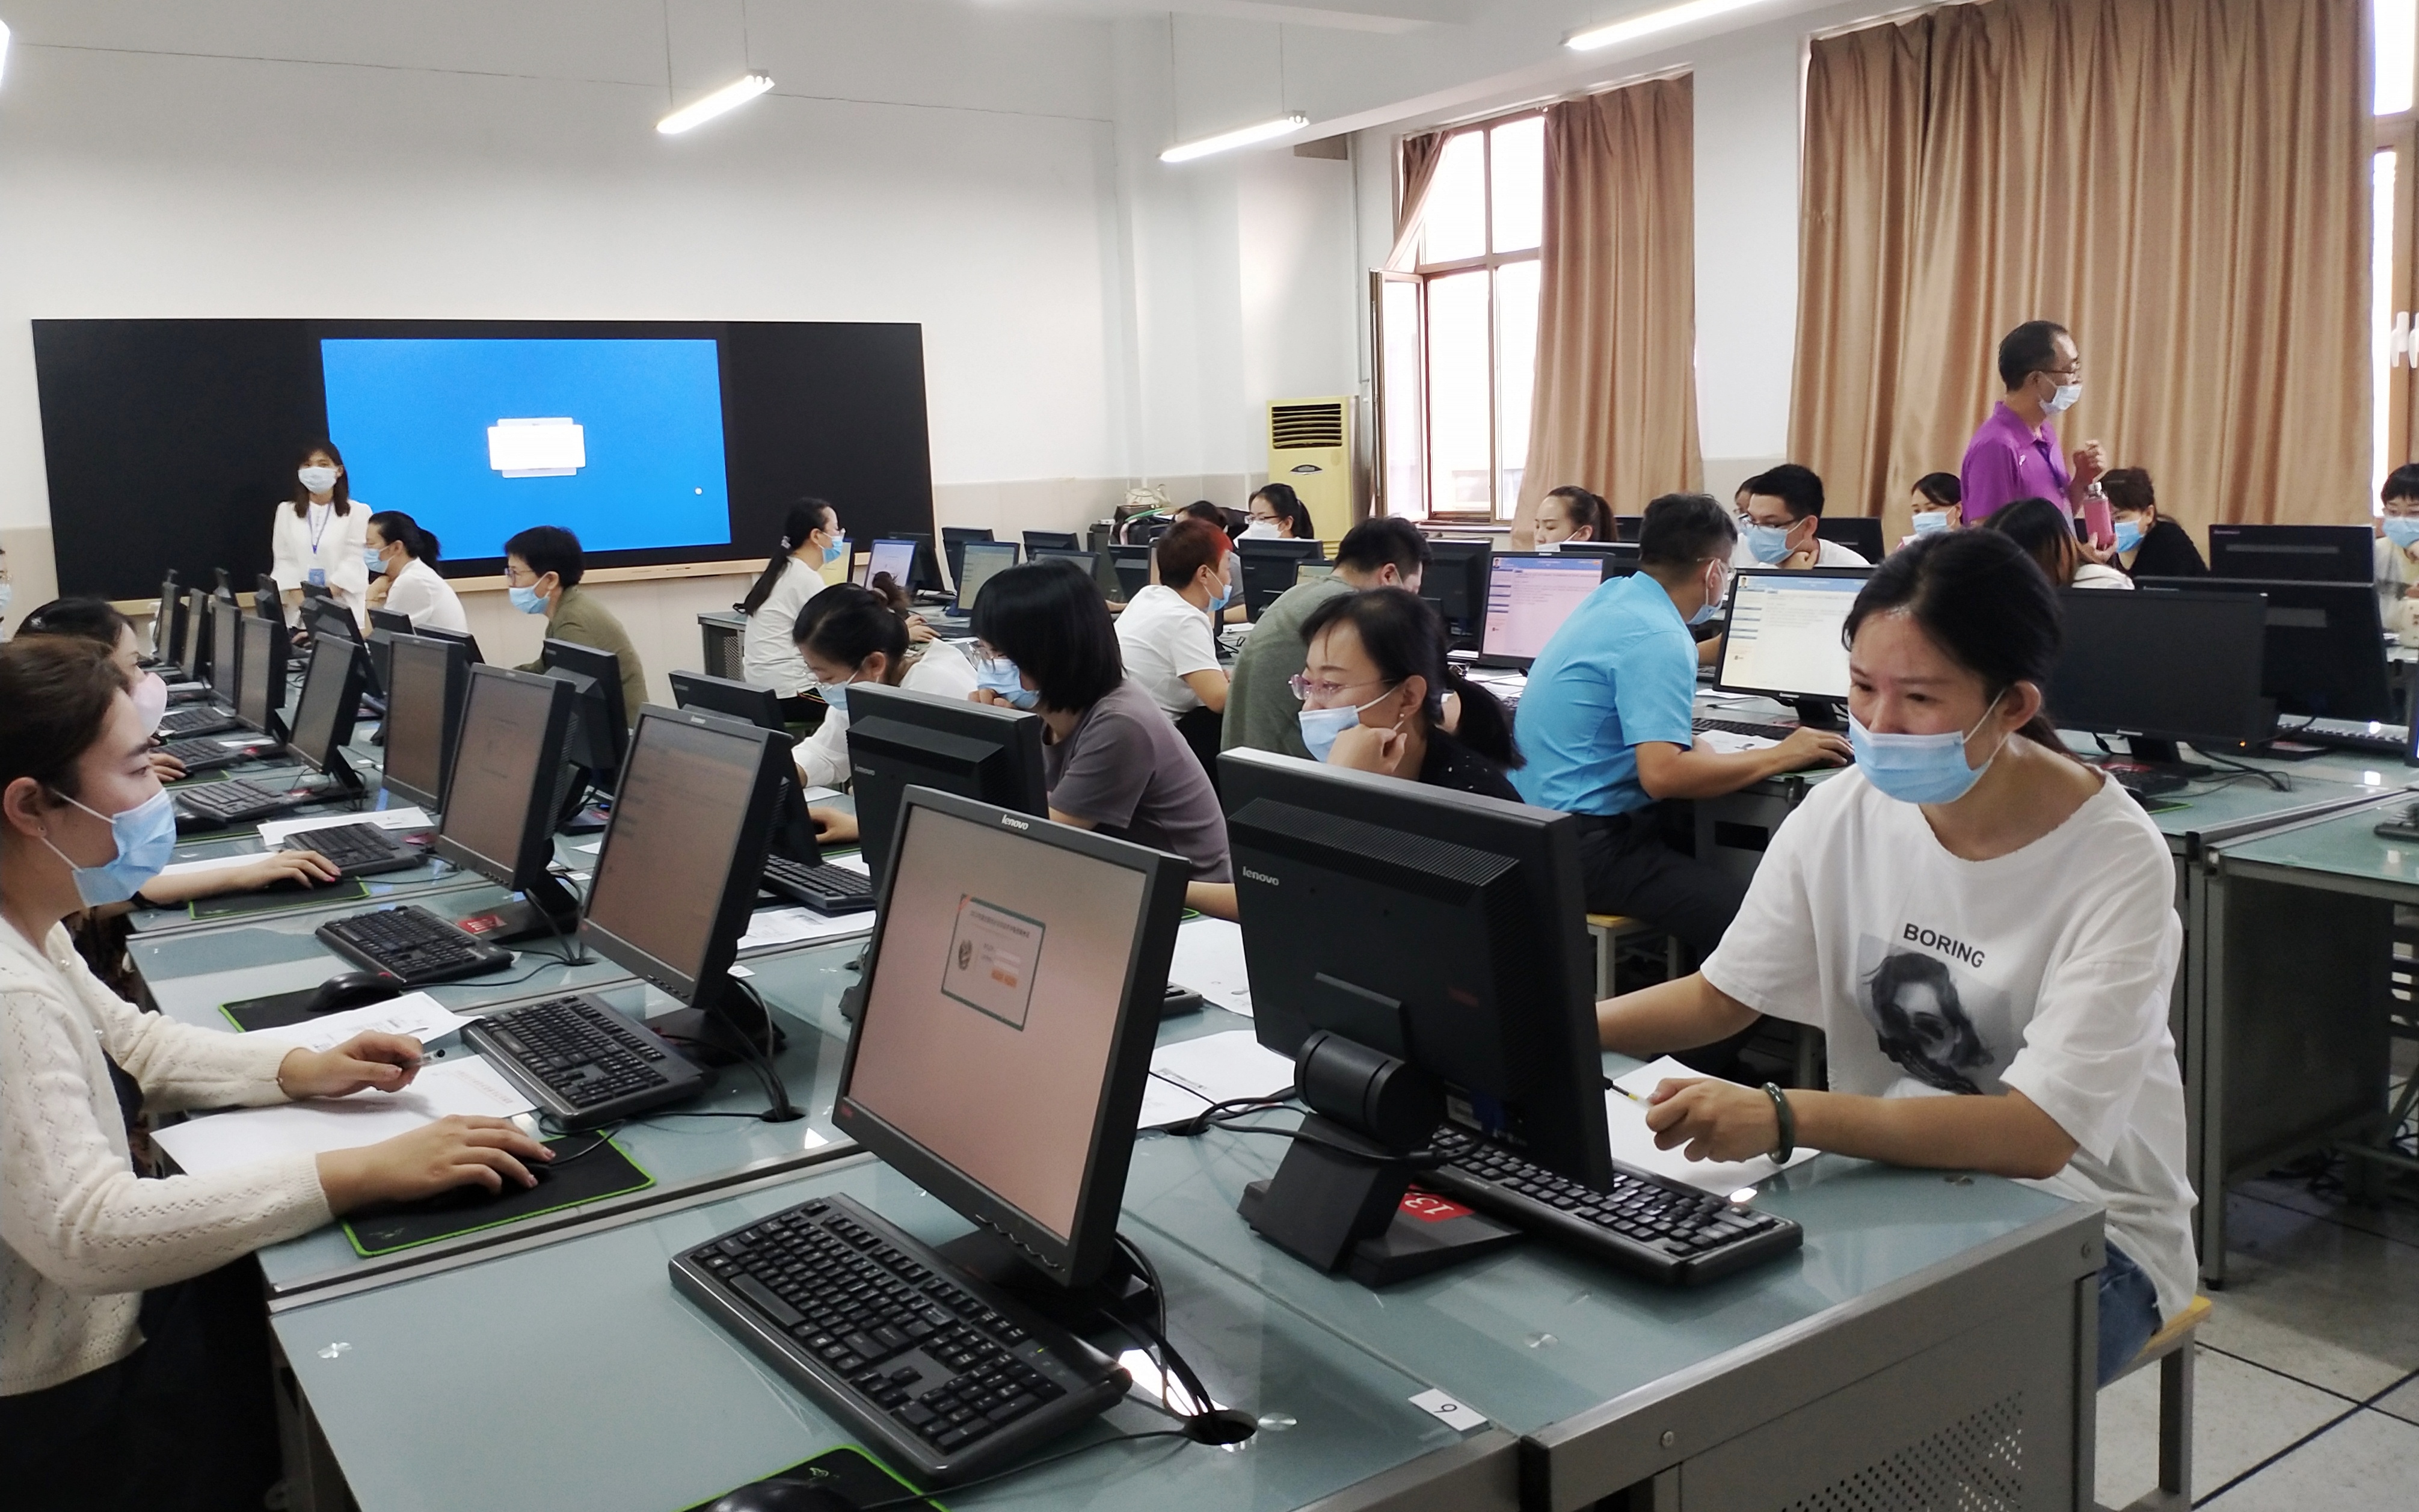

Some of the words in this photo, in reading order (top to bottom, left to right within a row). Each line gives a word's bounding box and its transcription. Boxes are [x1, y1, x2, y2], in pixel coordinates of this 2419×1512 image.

[1001, 814, 1029, 830] lenovo
[1243, 865, 1280, 886] lenovo
[1903, 923, 1985, 968] BORING
[1404, 1193, 1454, 1214] 13
